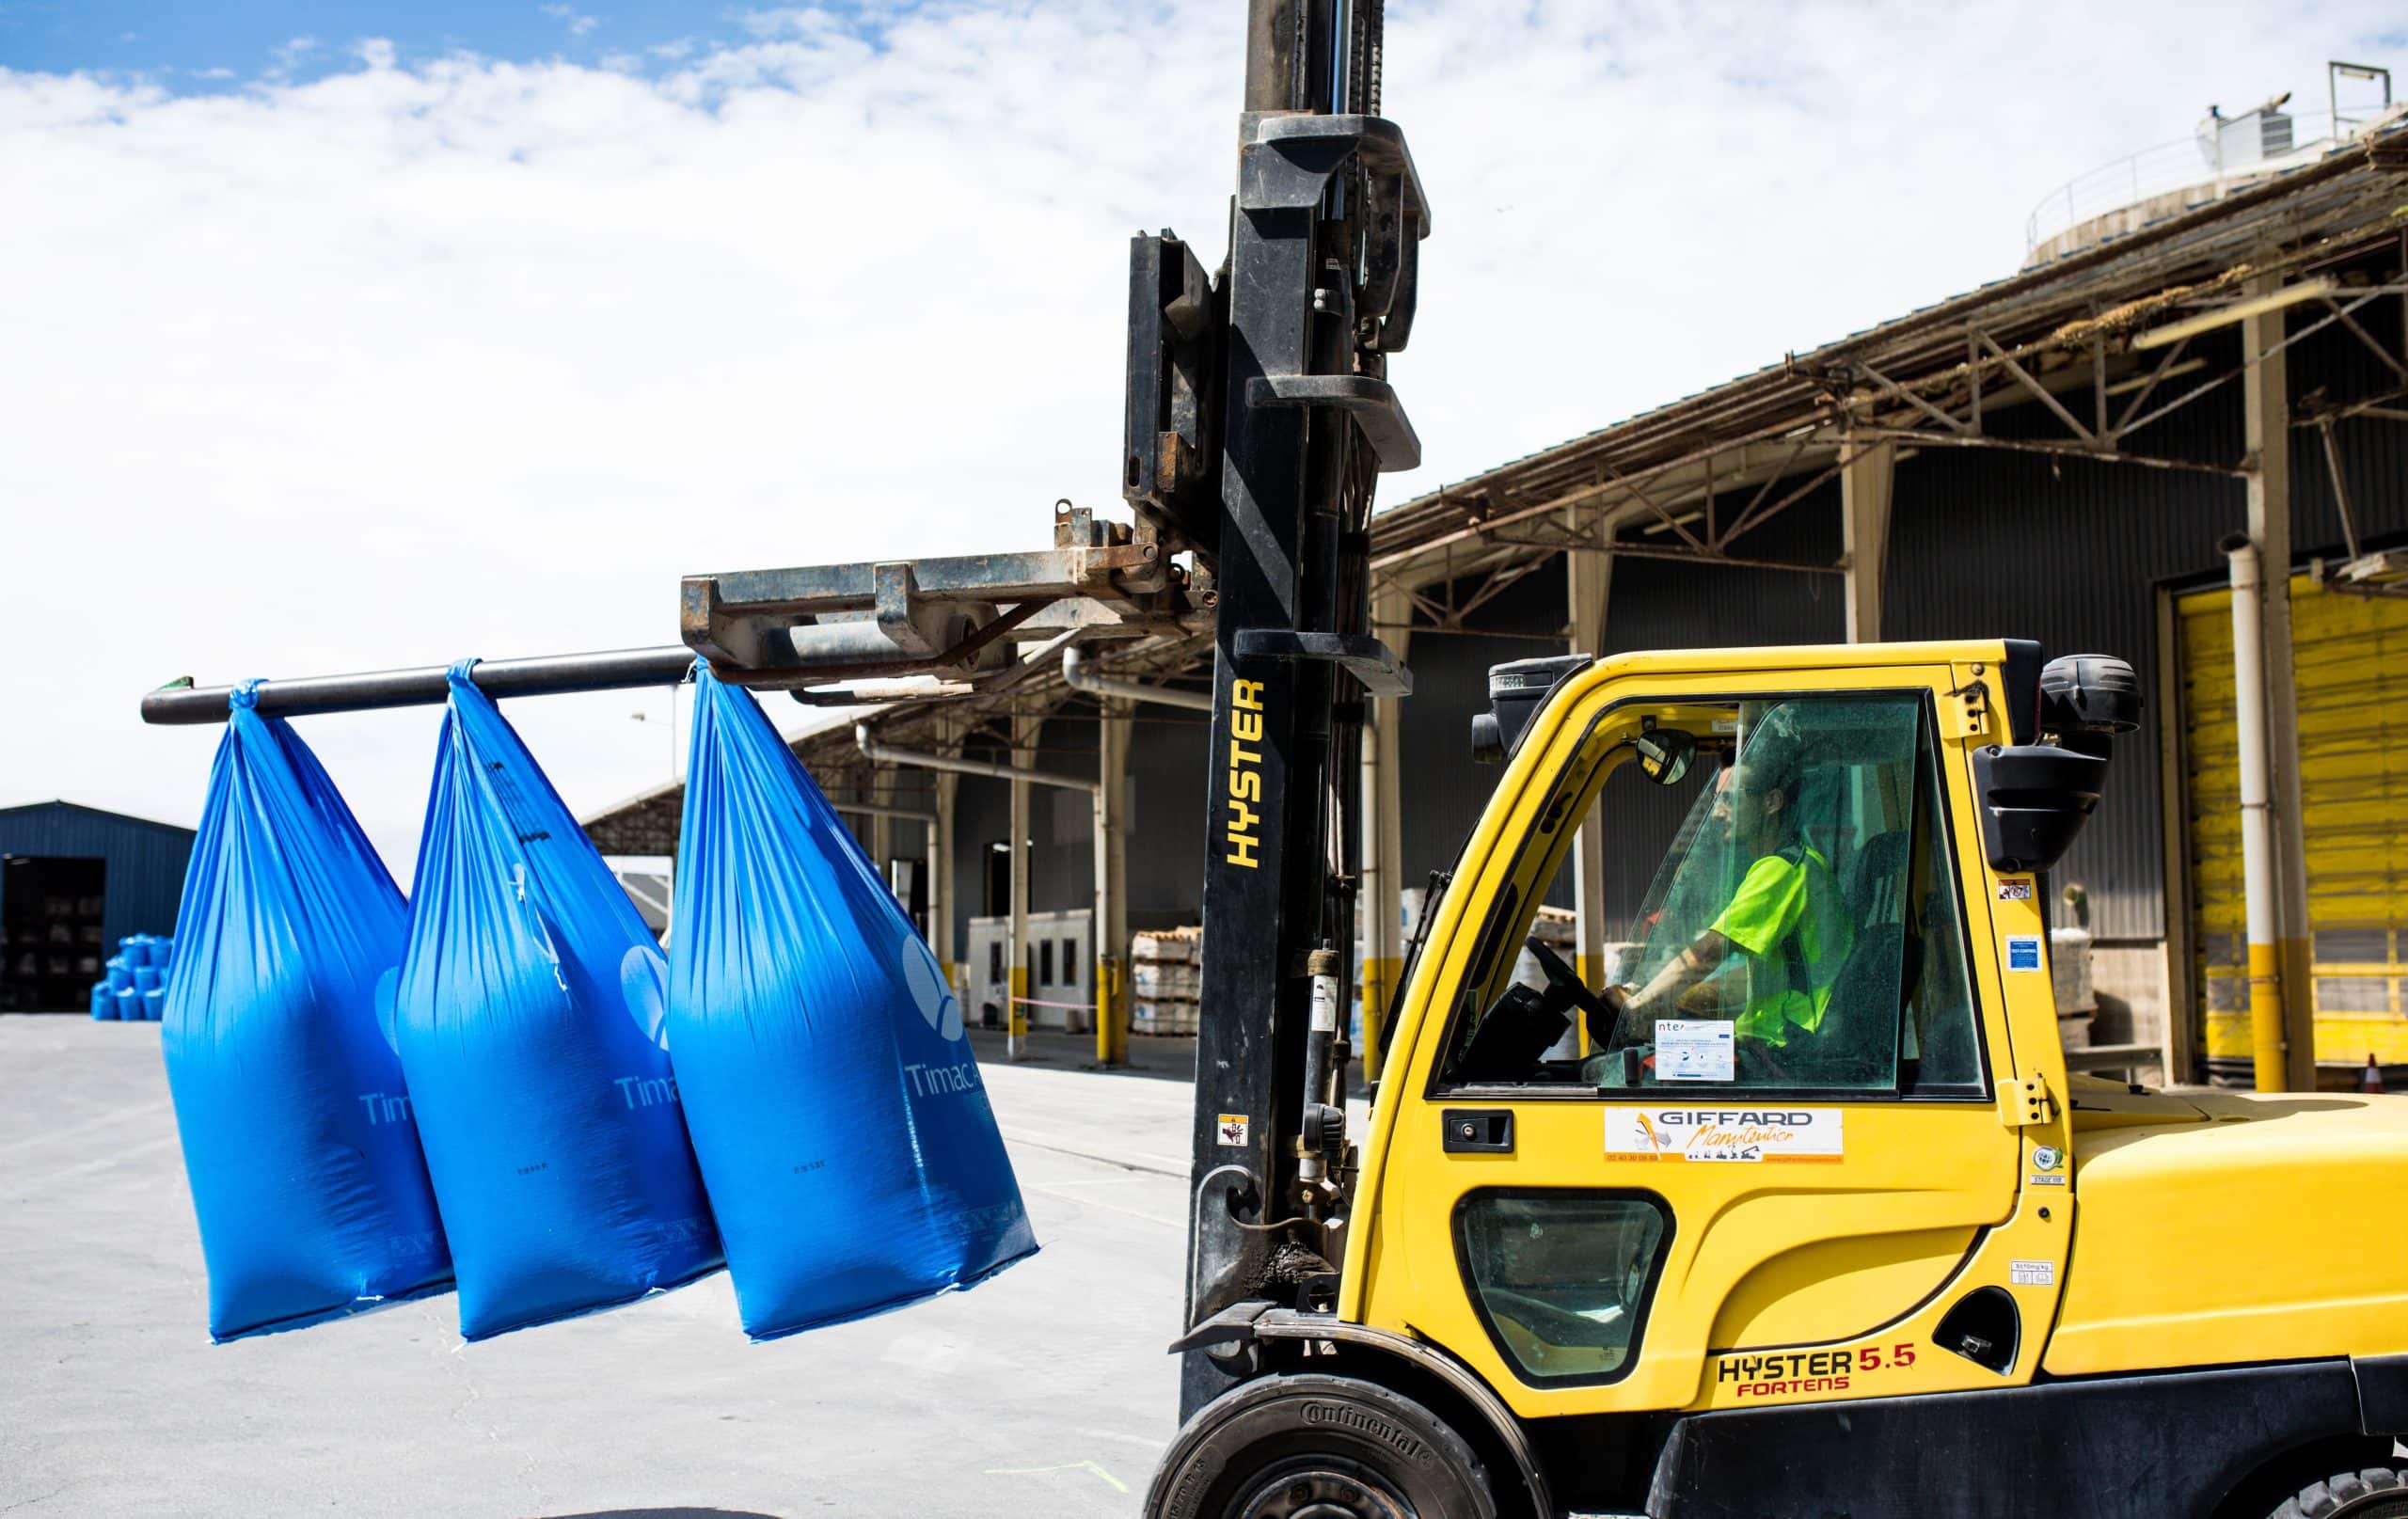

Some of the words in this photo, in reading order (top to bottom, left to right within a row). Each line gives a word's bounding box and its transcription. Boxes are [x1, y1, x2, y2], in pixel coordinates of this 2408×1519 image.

[1227, 678, 1264, 868] HYSTER
[904, 1063, 974, 1097] Timac
[1658, 1112, 1813, 1126] GIFFARD
[1719, 1352, 1852, 1382] HYSTER
[1859, 1343, 1916, 1370] 5.5
[1737, 1377, 1849, 1397] FORTENS
[1300, 1401, 1422, 1460] Continental
